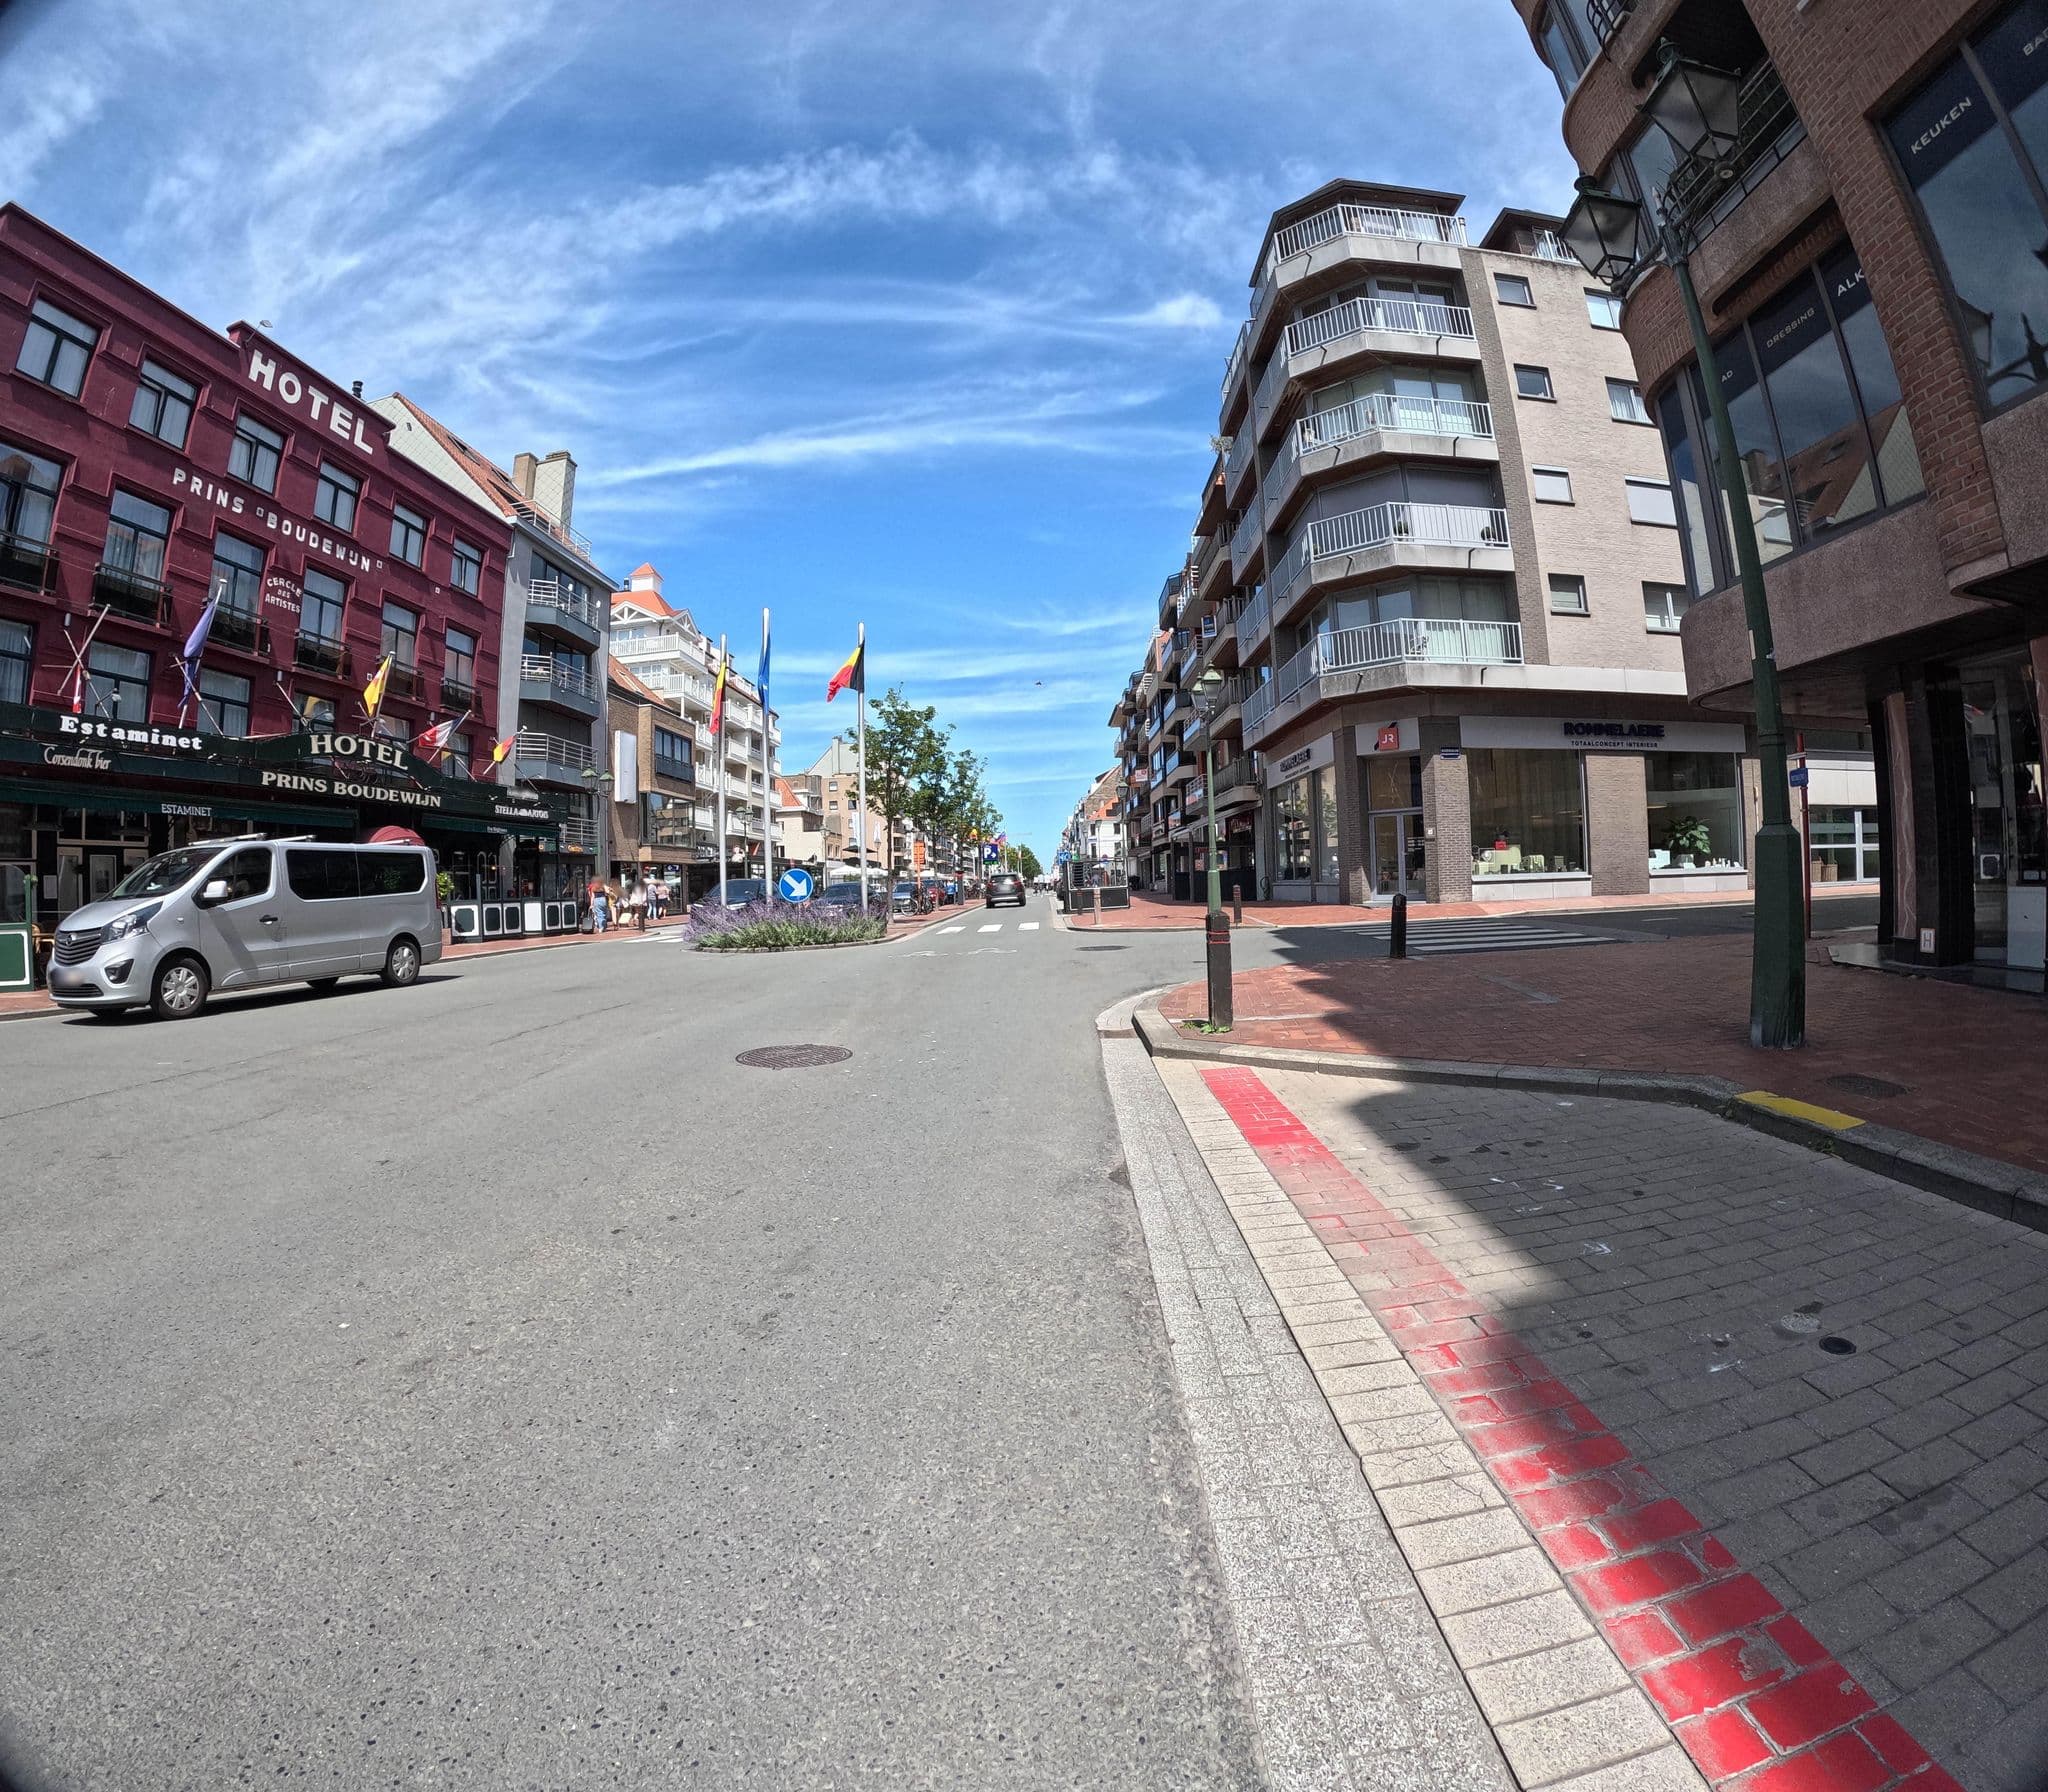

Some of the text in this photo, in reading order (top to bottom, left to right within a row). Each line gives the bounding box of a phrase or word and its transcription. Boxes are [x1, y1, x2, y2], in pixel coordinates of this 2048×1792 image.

[1911, 97, 1972, 154] KEUKEN
[1766, 307, 1816, 349] DRESSING
[248, 349, 373, 455] HOTEL
[172, 467, 245, 514] PRINS
[266, 577, 302, 598] CERCLE
[265, 593, 301, 614] ARTISTES
[60, 715, 203, 750] Estaminet
[1381, 734, 1394, 744] JR
[1571, 740, 1624, 748] TOTAALCONCEPT
[44, 747, 112, 771] Corsendonk bier
[310, 734, 409, 770] HOTEL
[262, 771, 441, 808] PRINS BOUDEWIJN
[161, 803, 212, 817] ESTAMINET
[495, 804, 518, 816] STELLA
[984, 847, 991, 859] P
